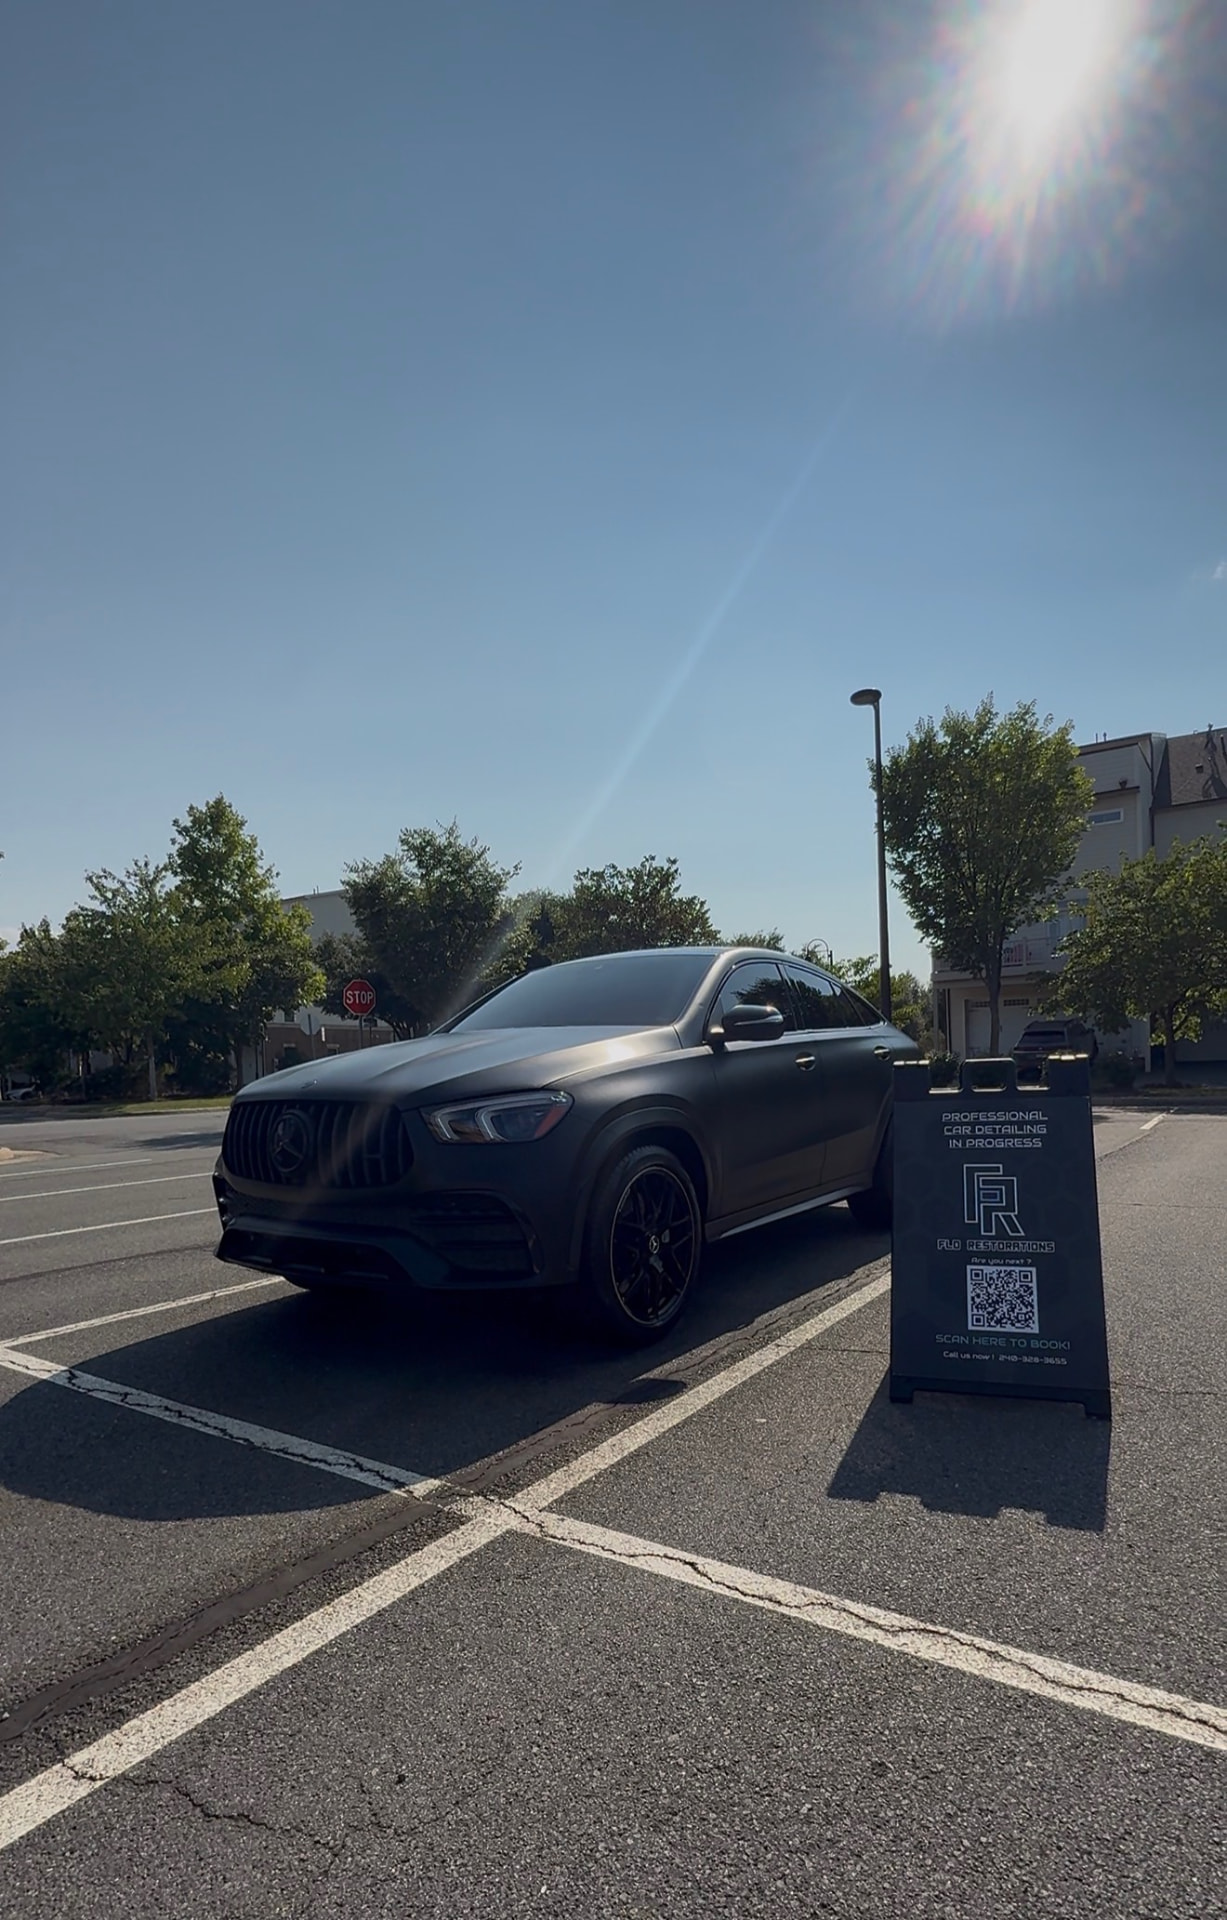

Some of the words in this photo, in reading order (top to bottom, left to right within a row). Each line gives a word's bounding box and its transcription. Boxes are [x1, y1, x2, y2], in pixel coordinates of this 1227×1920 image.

[346, 990, 373, 1004] STOP
[942, 1111, 1048, 1122] PROFESSIONAL
[943, 1125, 971, 1136] CAR
[975, 1124, 1047, 1135] DETAILING
[949, 1139, 962, 1148] IN
[966, 1138, 1042, 1148] PROGRESS
[937, 1238, 961, 1251] FLO
[967, 1239, 1056, 1253] RESTORATIONS
[935, 1334, 969, 1344] SCAN
[972, 1336, 1007, 1347] HERE
[1010, 1338, 1027, 1348] TO
[1030, 1339, 1071, 1350] BOOK!
[943, 1350, 959, 1359] Call
